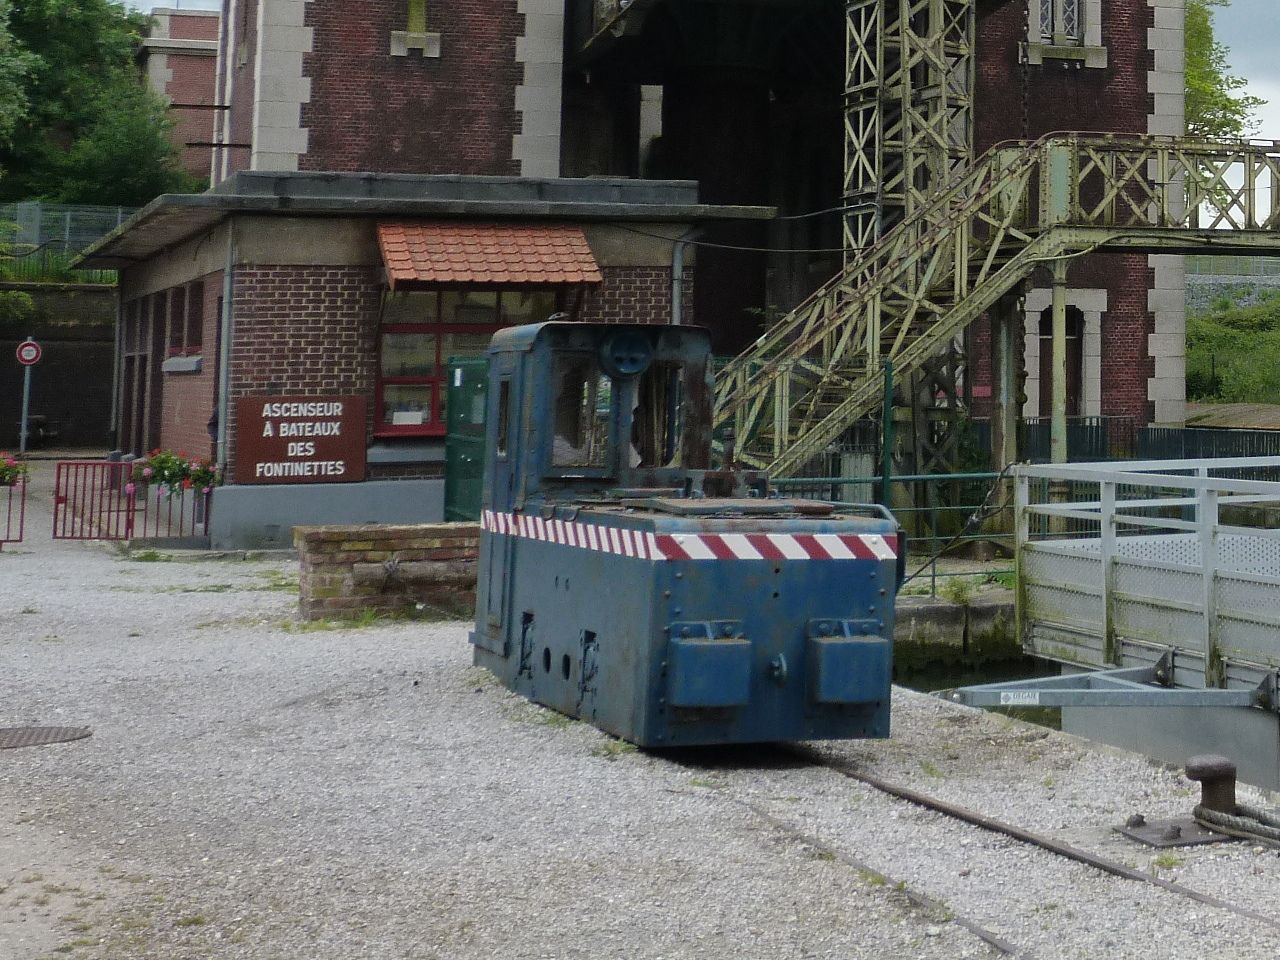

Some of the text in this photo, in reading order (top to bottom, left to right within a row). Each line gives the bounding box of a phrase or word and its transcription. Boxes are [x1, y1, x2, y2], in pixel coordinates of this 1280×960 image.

[262, 403, 343, 417] ASCENSEUR
[262, 421, 341, 437] À BATEAUX
[287, 442, 315, 456] DES
[255, 461, 345, 477] FONTINETTES
